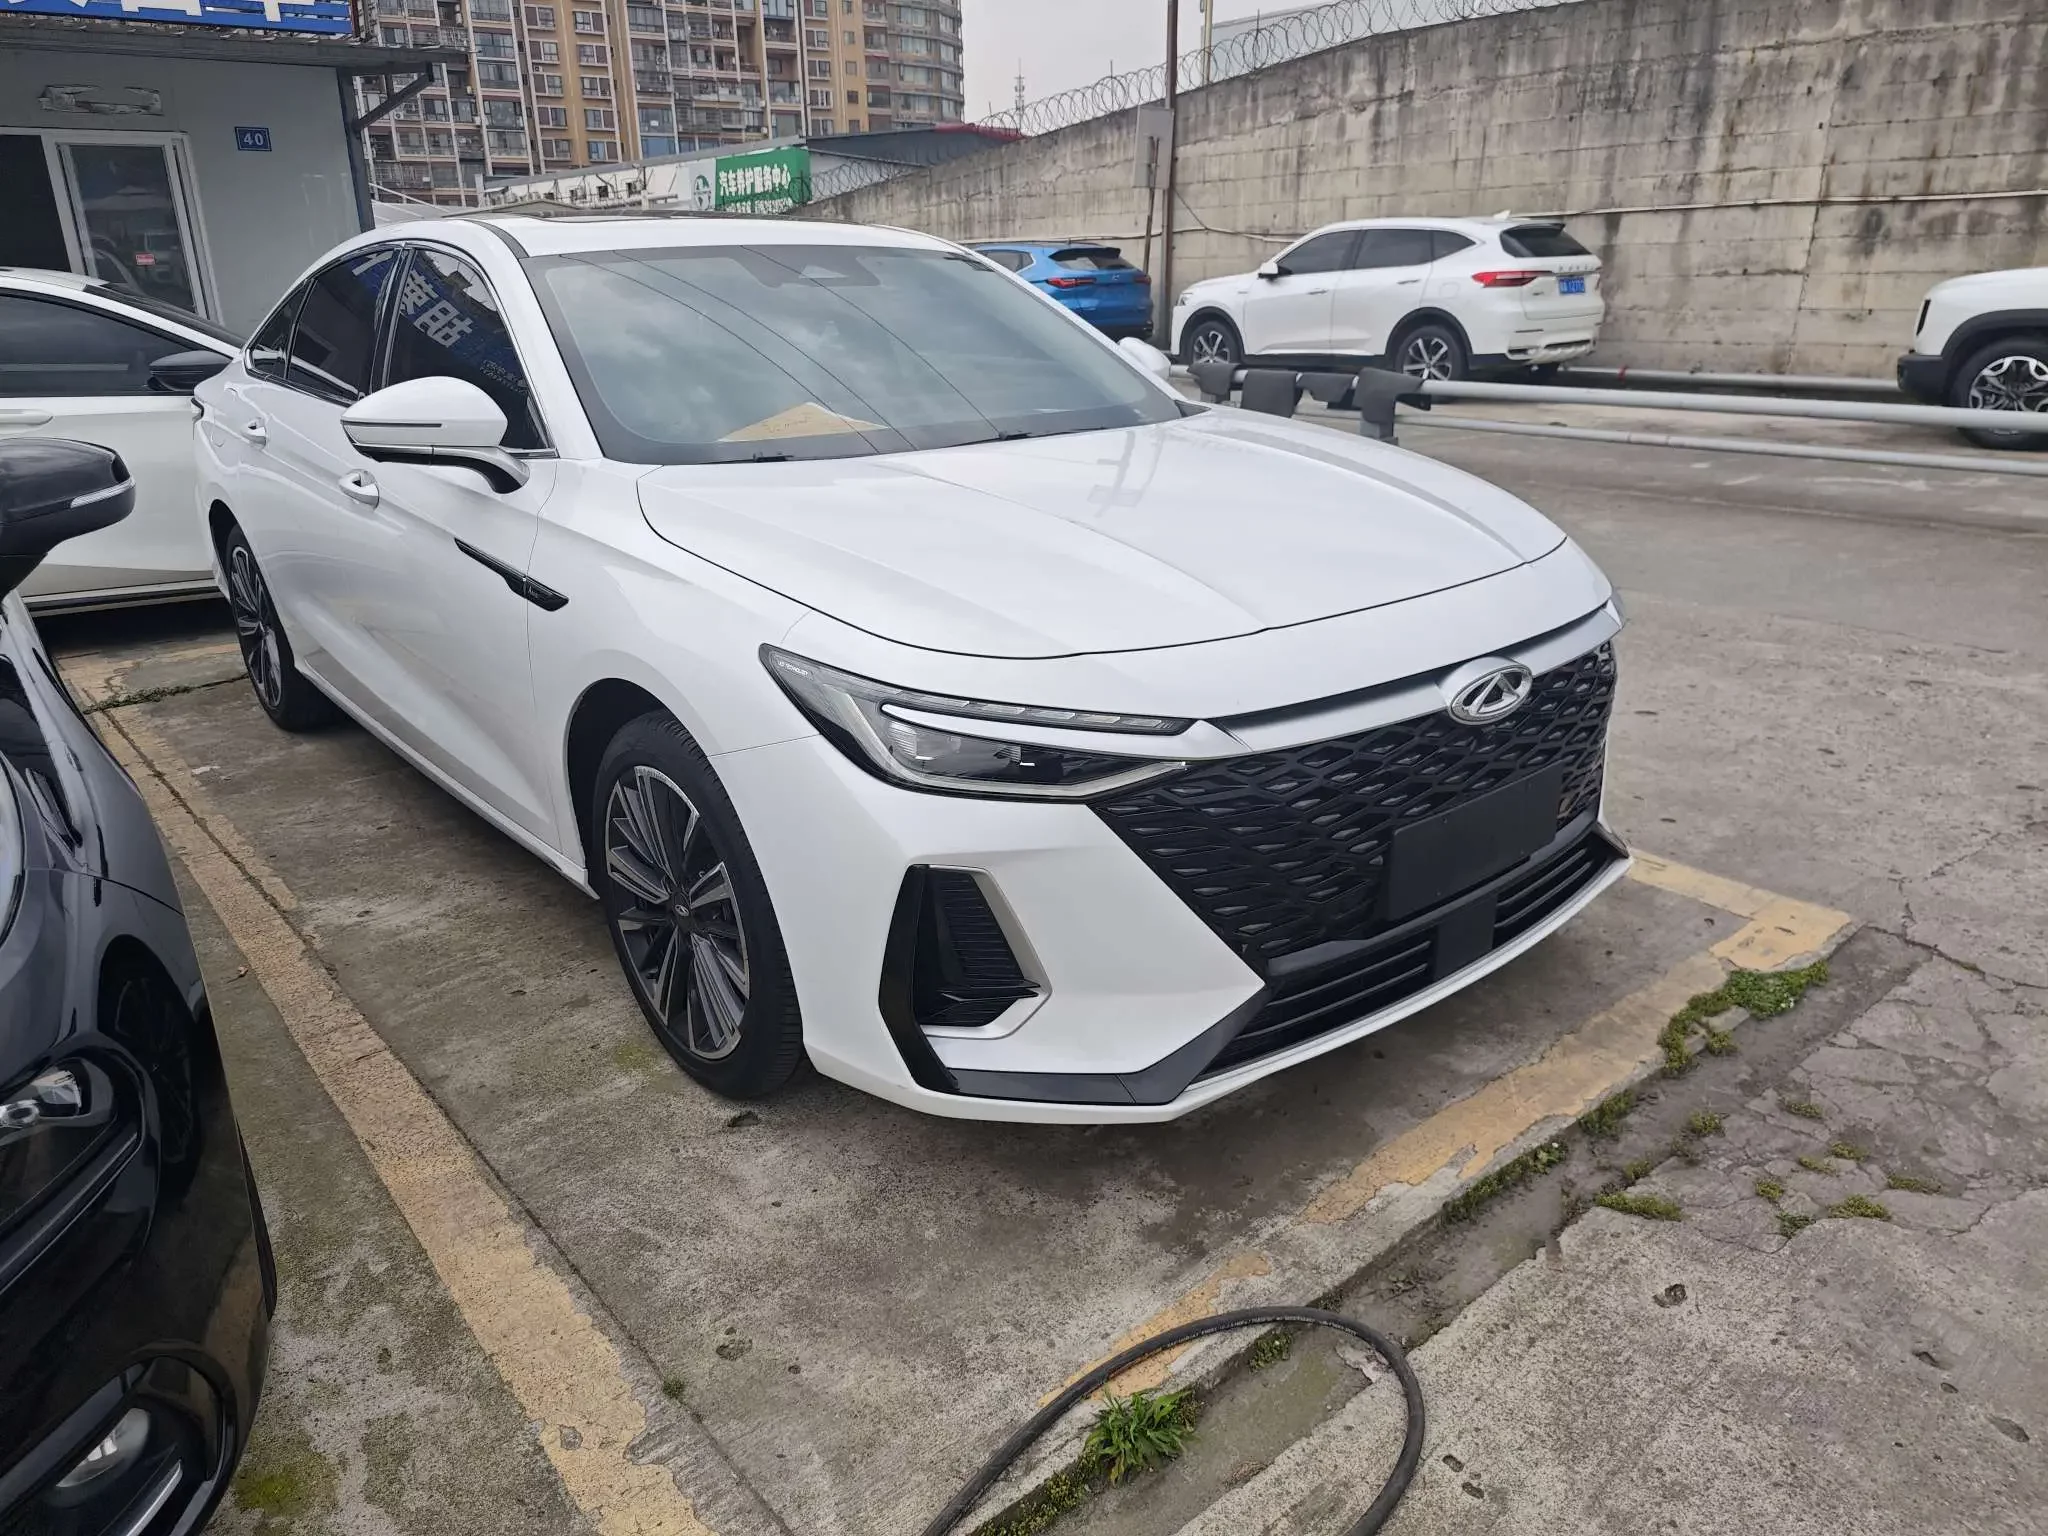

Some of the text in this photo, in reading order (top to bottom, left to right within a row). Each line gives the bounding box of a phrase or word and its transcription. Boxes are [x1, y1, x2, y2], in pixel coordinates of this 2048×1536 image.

[243, 132, 264, 146] 40
[719, 163, 791, 197] 汽车养护服务中心
